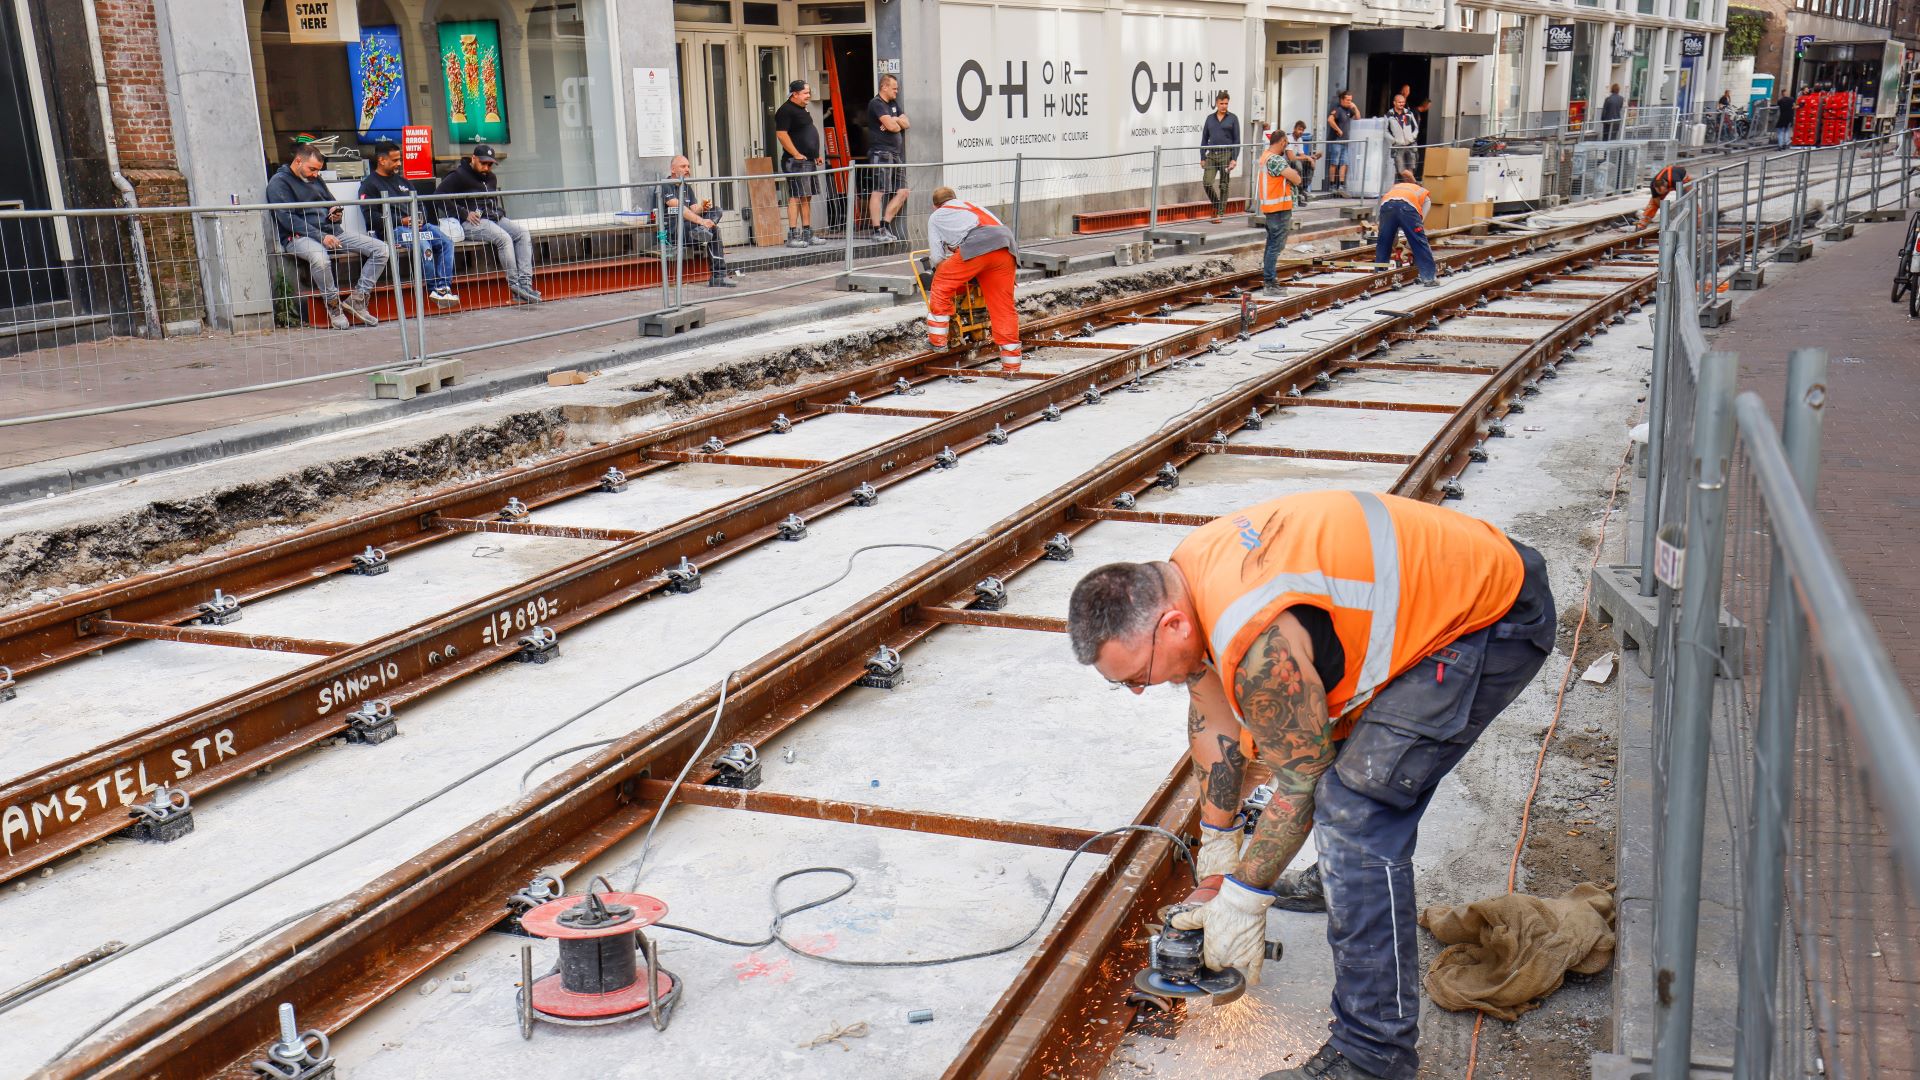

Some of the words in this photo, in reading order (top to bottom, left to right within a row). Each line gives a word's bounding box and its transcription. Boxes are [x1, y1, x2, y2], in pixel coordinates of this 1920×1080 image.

[295, 3, 328, 16] START
[300, 17, 328, 30] HERE
[1043, 92, 1089, 118] HUSE
[1131, 128, 1151, 137] MODERN
[956, 137, 984, 149] MODERN
[985, 136, 1010, 147] MUUM
[1011, 135, 1020, 145] OF
[1020, 133, 1052, 145] ELECTRONIC
[1069, 131, 1089, 142] CULTURE
[405, 152, 419, 160] US?
